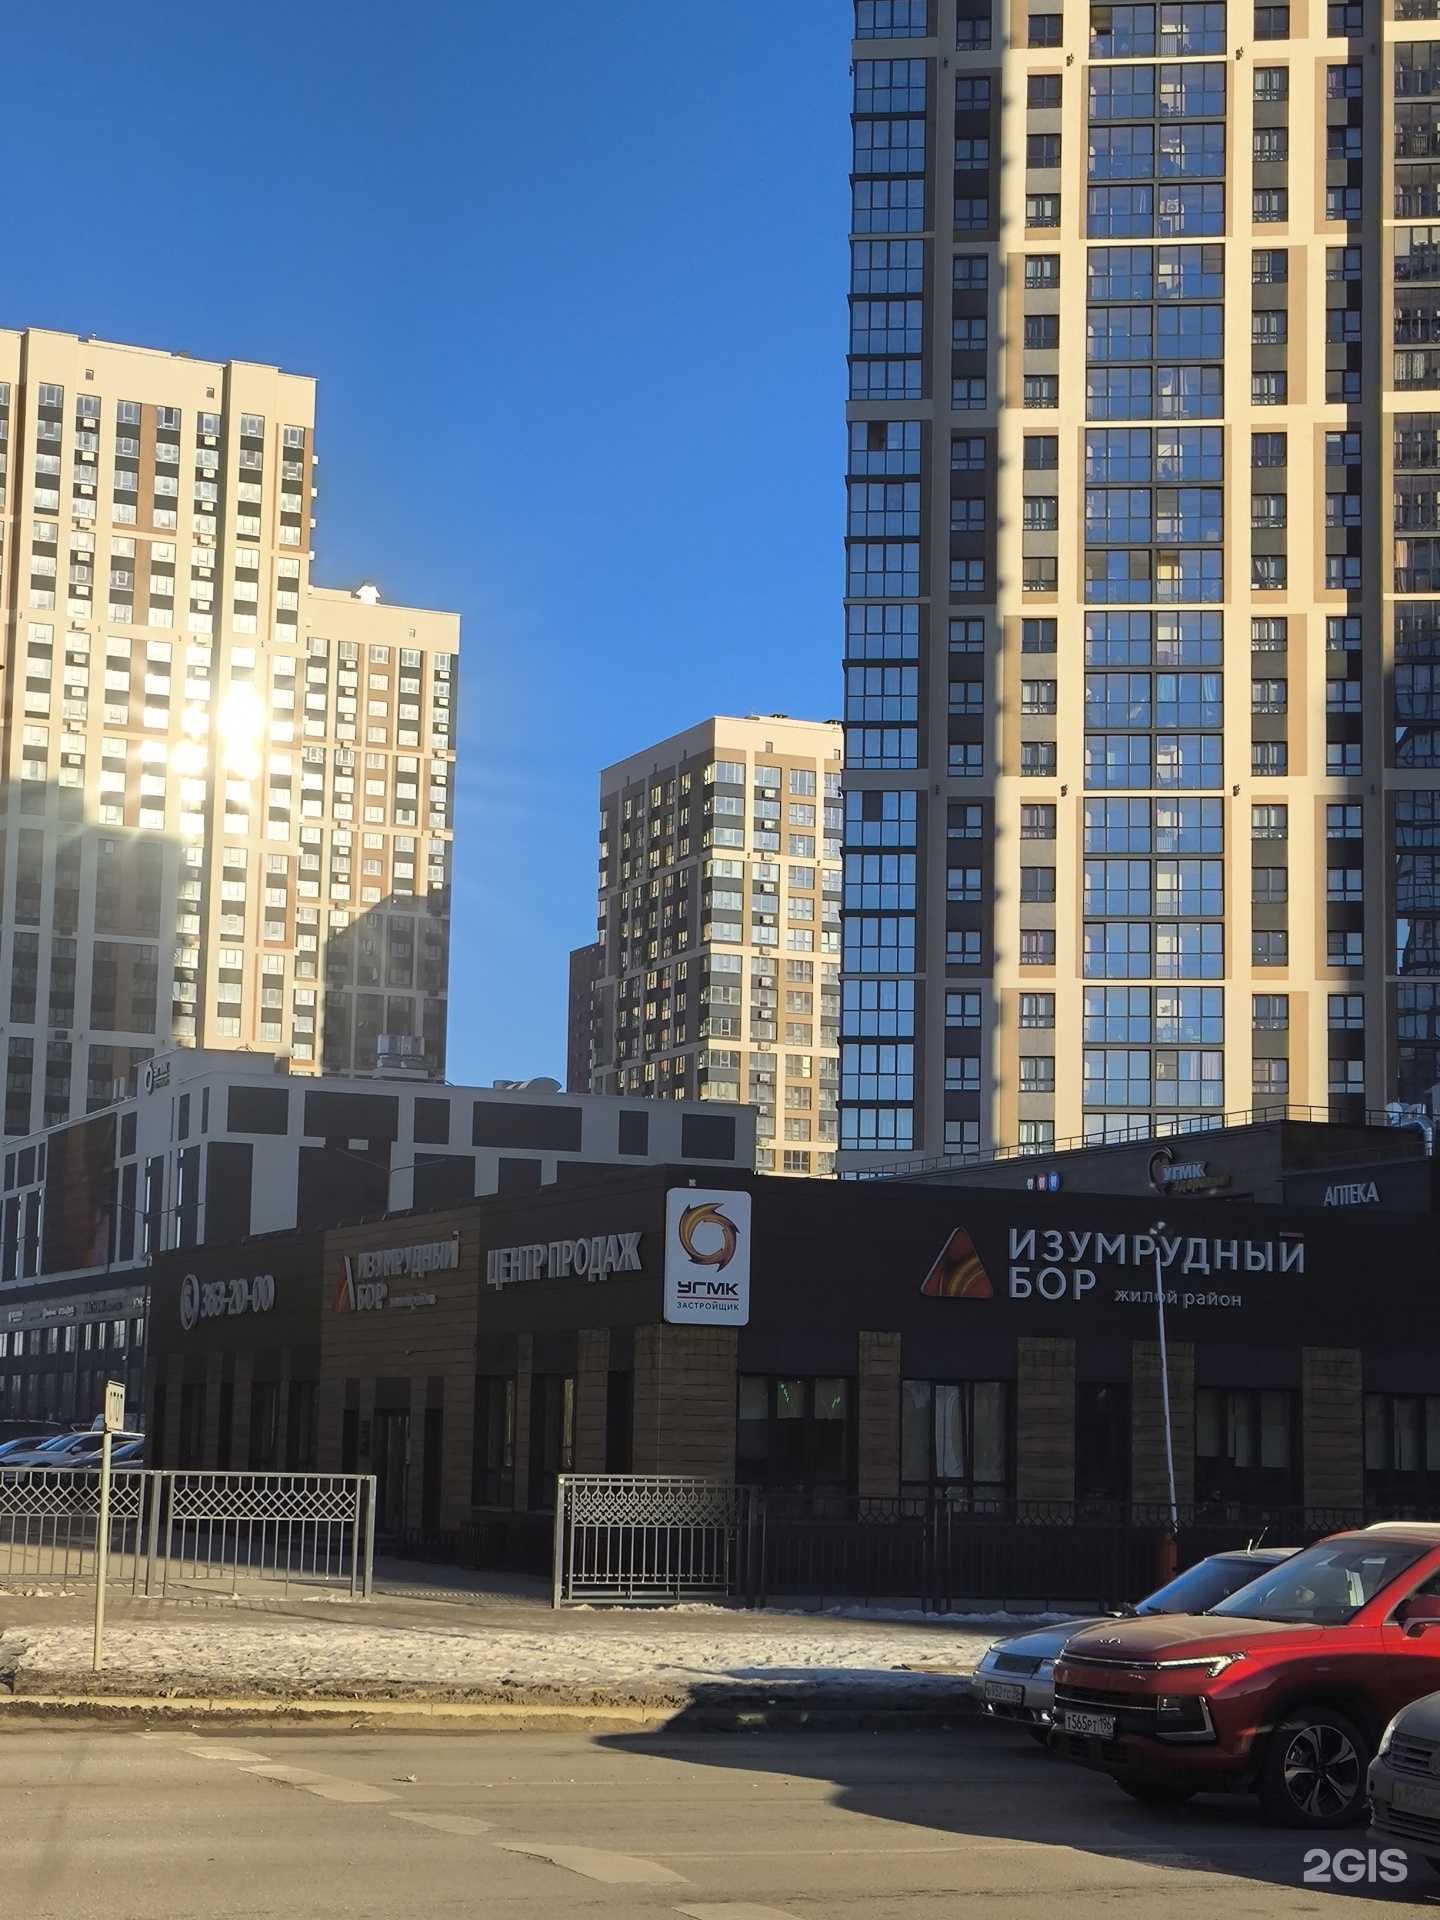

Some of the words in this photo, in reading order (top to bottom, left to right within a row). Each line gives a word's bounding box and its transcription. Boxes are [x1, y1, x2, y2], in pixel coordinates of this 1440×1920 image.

[1323, 1182, 1380, 1207] АПТЕКА
[487, 1244, 546, 1291] ЦЕНТР
[548, 1231, 643, 1282] ПРОДАЖ
[1008, 1228, 1305, 1275] ИЗУМРУДНЫЙ
[677, 1281, 739, 1297] УГМК
[1008, 1265, 1097, 1301] БОР
[676, 1300, 740, 1313] ЗАСТРОЙЩИК
[1183, 1291, 1243, 1309] район
